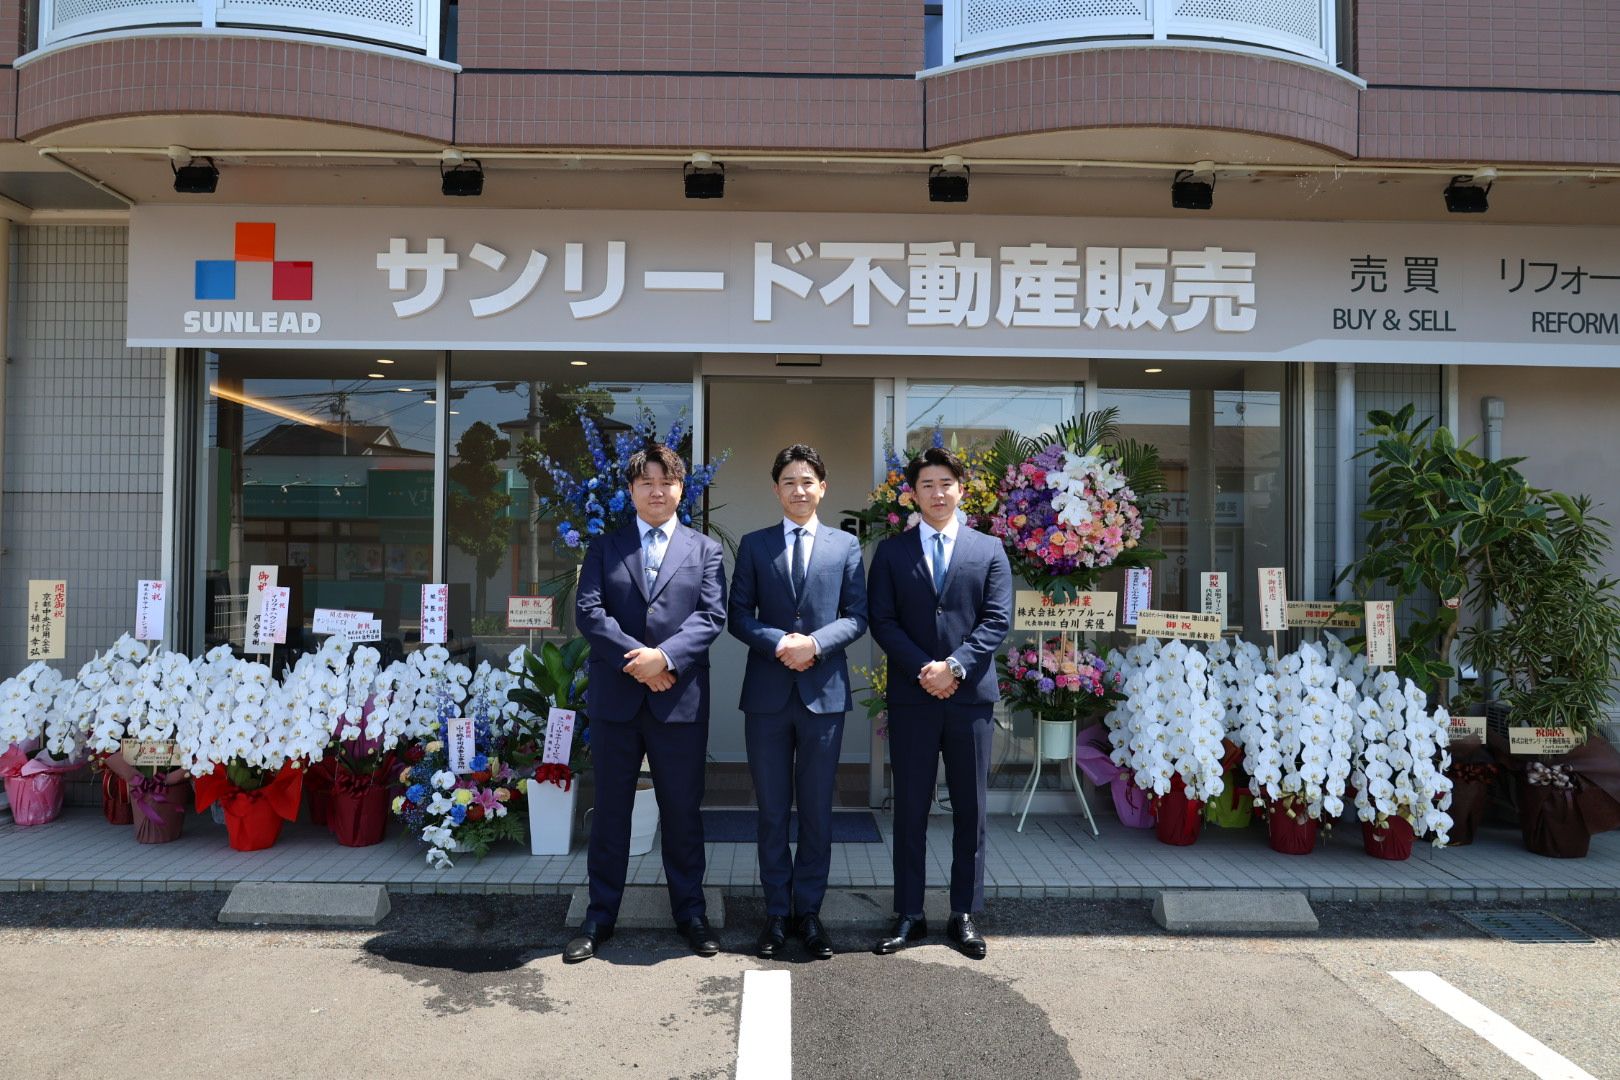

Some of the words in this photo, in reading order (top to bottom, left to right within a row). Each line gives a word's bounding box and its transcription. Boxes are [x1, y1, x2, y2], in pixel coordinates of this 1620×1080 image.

[376, 237, 1258, 333] サンリード不動産販売
[183, 310, 322, 334] SUNLEAD
[1333, 308, 1377, 330] BUY
[1382, 309, 1401, 331] &
[1408, 310, 1456, 332] SELL
[1532, 311, 1619, 334] REFORM
[1209, 574, 1219, 588] 御祝
[53, 583, 65, 618] 開店御祝
[1017, 607, 1114, 618] 株式会社ケアブルーム
[41, 593, 52, 655] 京都中央信用金庫
[1166, 621, 1192, 630] 御祝
